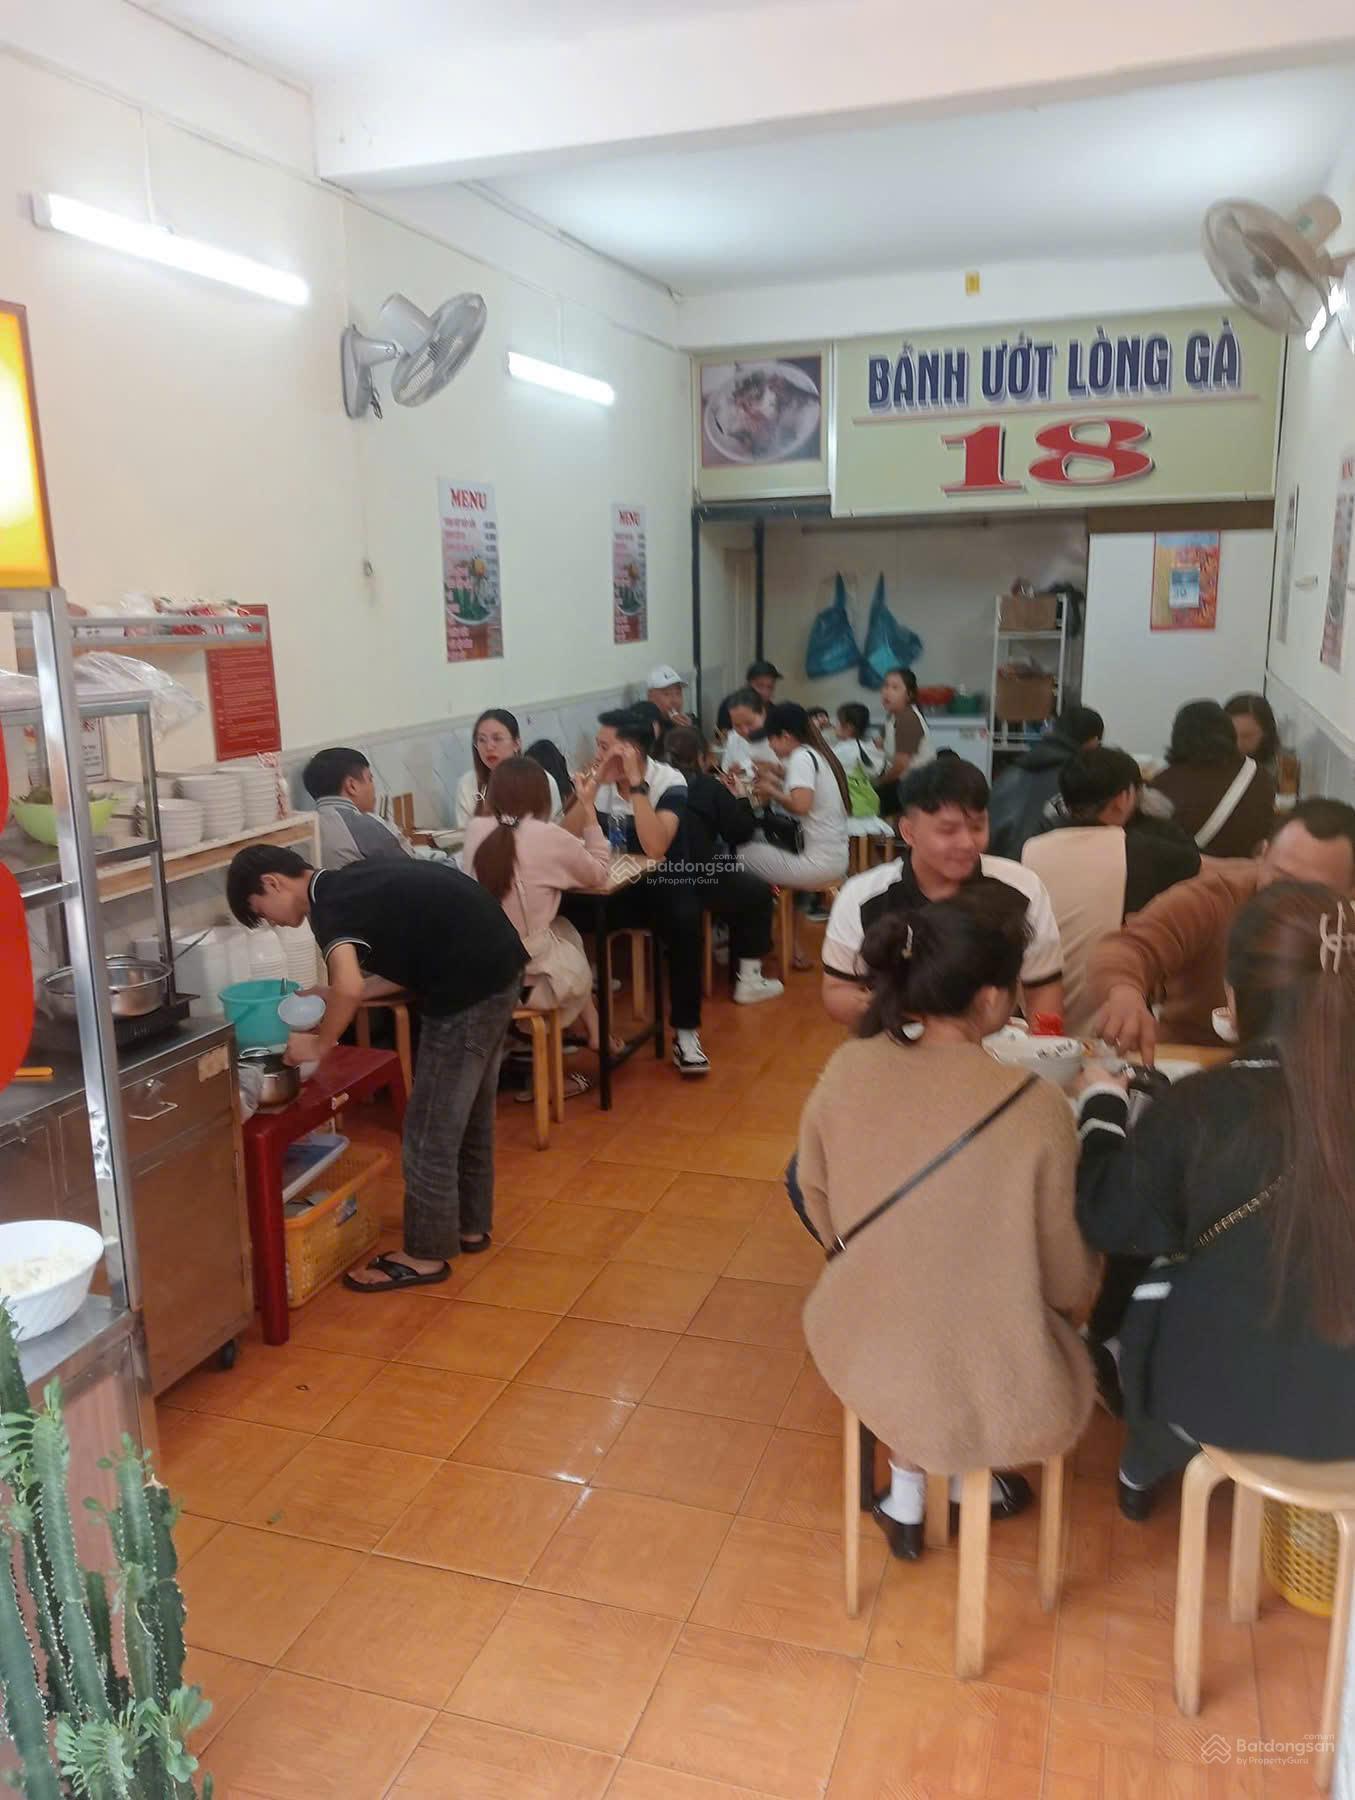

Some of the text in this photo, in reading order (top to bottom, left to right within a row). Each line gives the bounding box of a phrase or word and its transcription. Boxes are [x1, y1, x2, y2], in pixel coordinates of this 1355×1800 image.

[1067, 325, 1172, 396] LÒNG
[1185, 317, 1241, 390] GÀ
[941, 416, 1155, 495] 18
[450, 488, 487, 510] MENU
